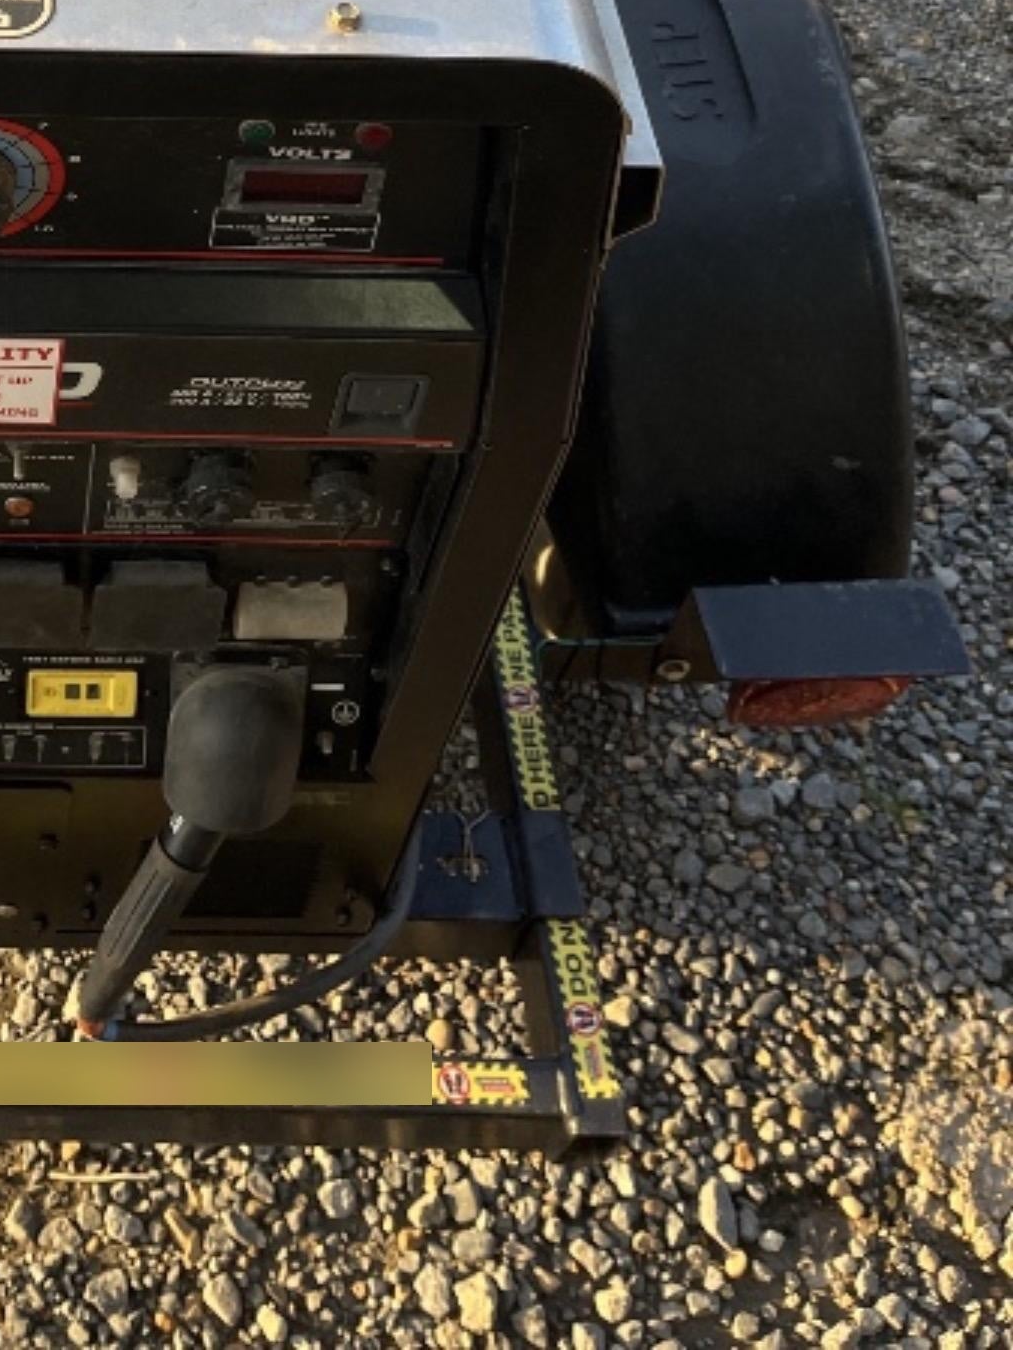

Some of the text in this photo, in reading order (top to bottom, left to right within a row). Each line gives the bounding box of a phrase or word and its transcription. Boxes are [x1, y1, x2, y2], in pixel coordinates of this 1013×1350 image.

[268, 146, 353, 160] VOLTS
[7, 377, 34, 386] UP
[519, 714, 548, 784] HERE
[565, 954, 587, 996] DO
